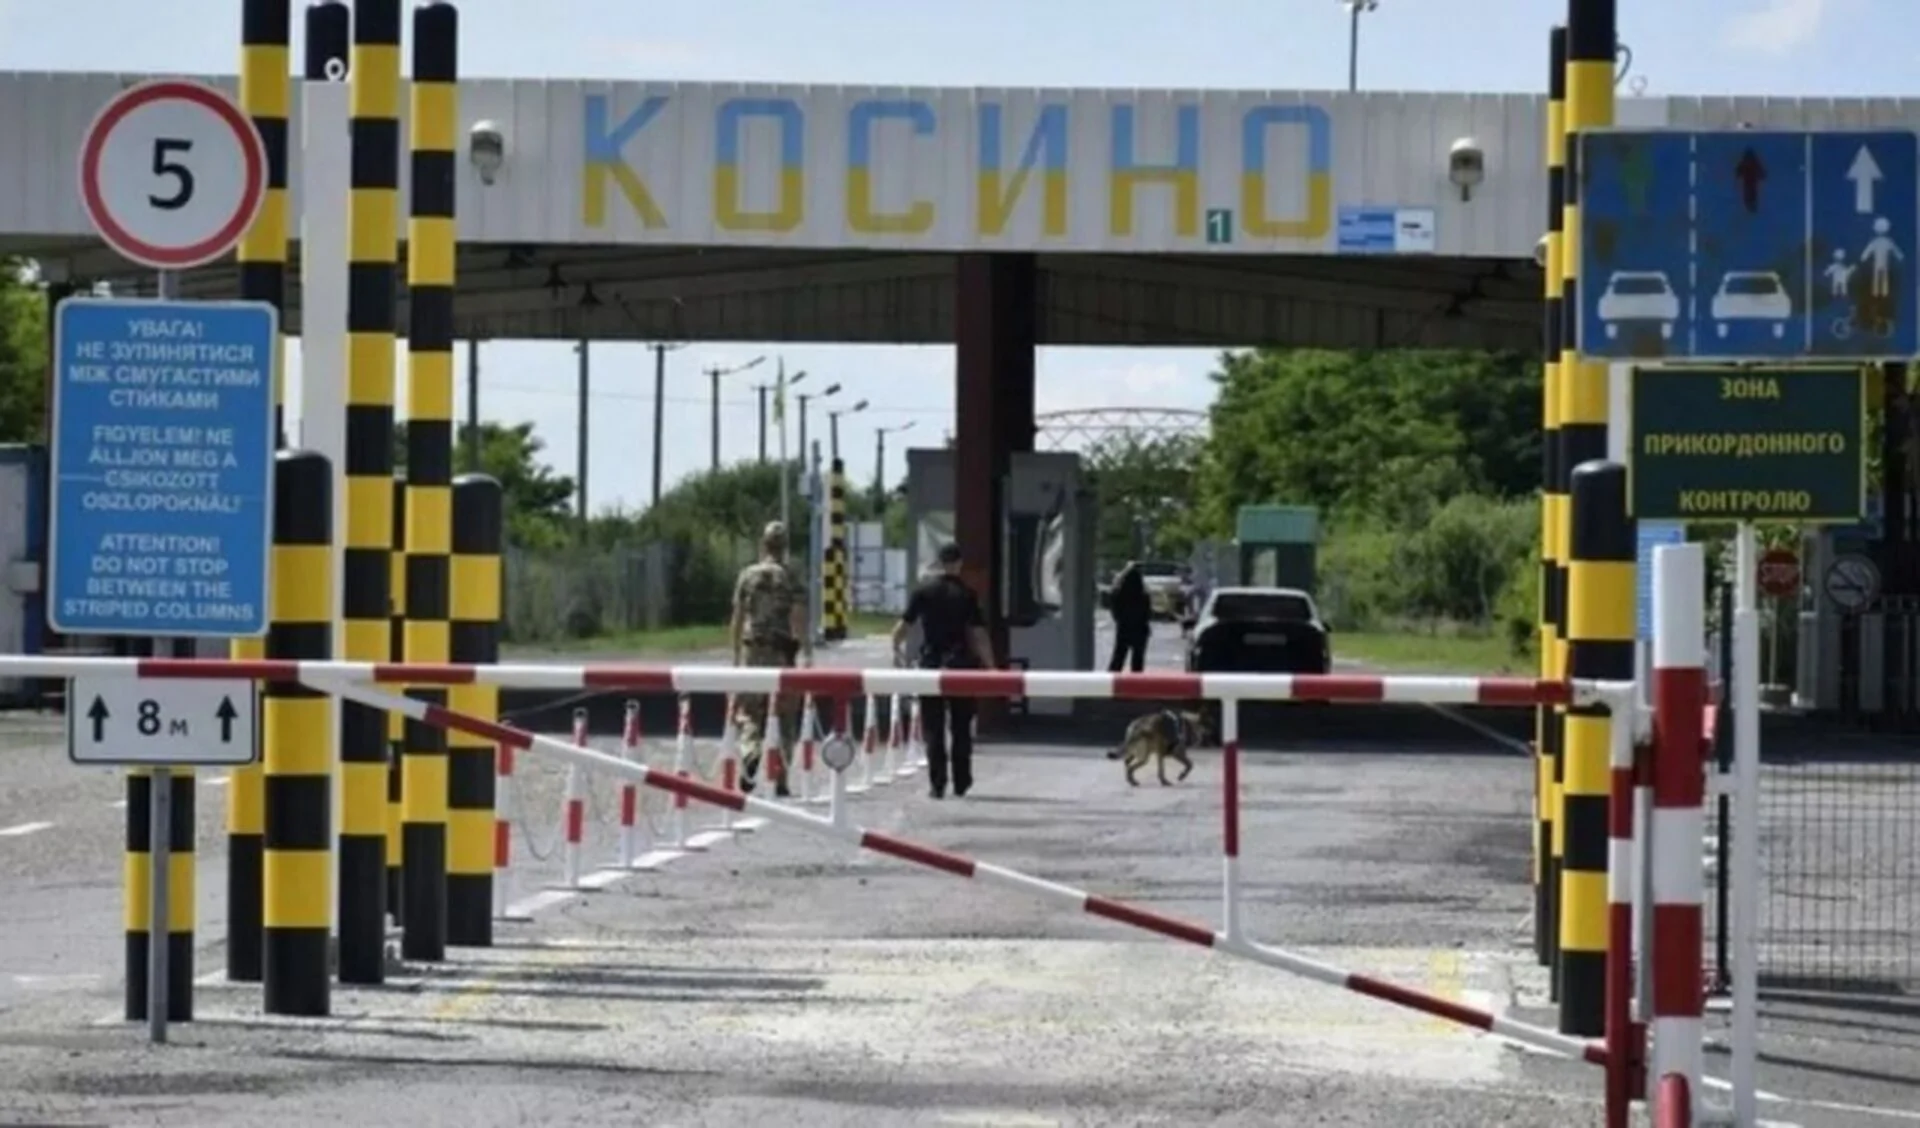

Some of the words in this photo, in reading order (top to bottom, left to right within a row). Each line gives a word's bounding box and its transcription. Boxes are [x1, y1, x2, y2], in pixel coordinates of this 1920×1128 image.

[148, 138, 195, 210] 5
[582, 95, 1331, 238] КОСИНО
[1208, 211, 1226, 240] 1
[128, 320, 204, 338] УВАГА!
[76, 341, 105, 359] НЕ
[111, 342, 254, 364] ЗУПИНЯТИСЯ
[115, 365, 261, 388] СМУГАСТИМИ
[1721, 377, 1780, 399] ЗОНА
[206, 427, 233, 445] NE
[1644, 432, 1845, 456] ПРИКОРДОННОГО
[173, 449, 218, 468] MEG
[222, 452, 238, 469] A
[1679, 491, 1811, 513] КОНТРОЛЮ
[101, 533, 220, 552] ATTENTION!
[92, 555, 121, 573] DO
[127, 556, 168, 574] NOT
[174, 557, 228, 576] STOP
[87, 577, 186, 597] BETWEEN
[193, 581, 231, 598] THE
[64, 600, 149, 619] STRIPED
[154, 602, 253, 621] COLUMNS
[137, 700, 161, 736] 8
